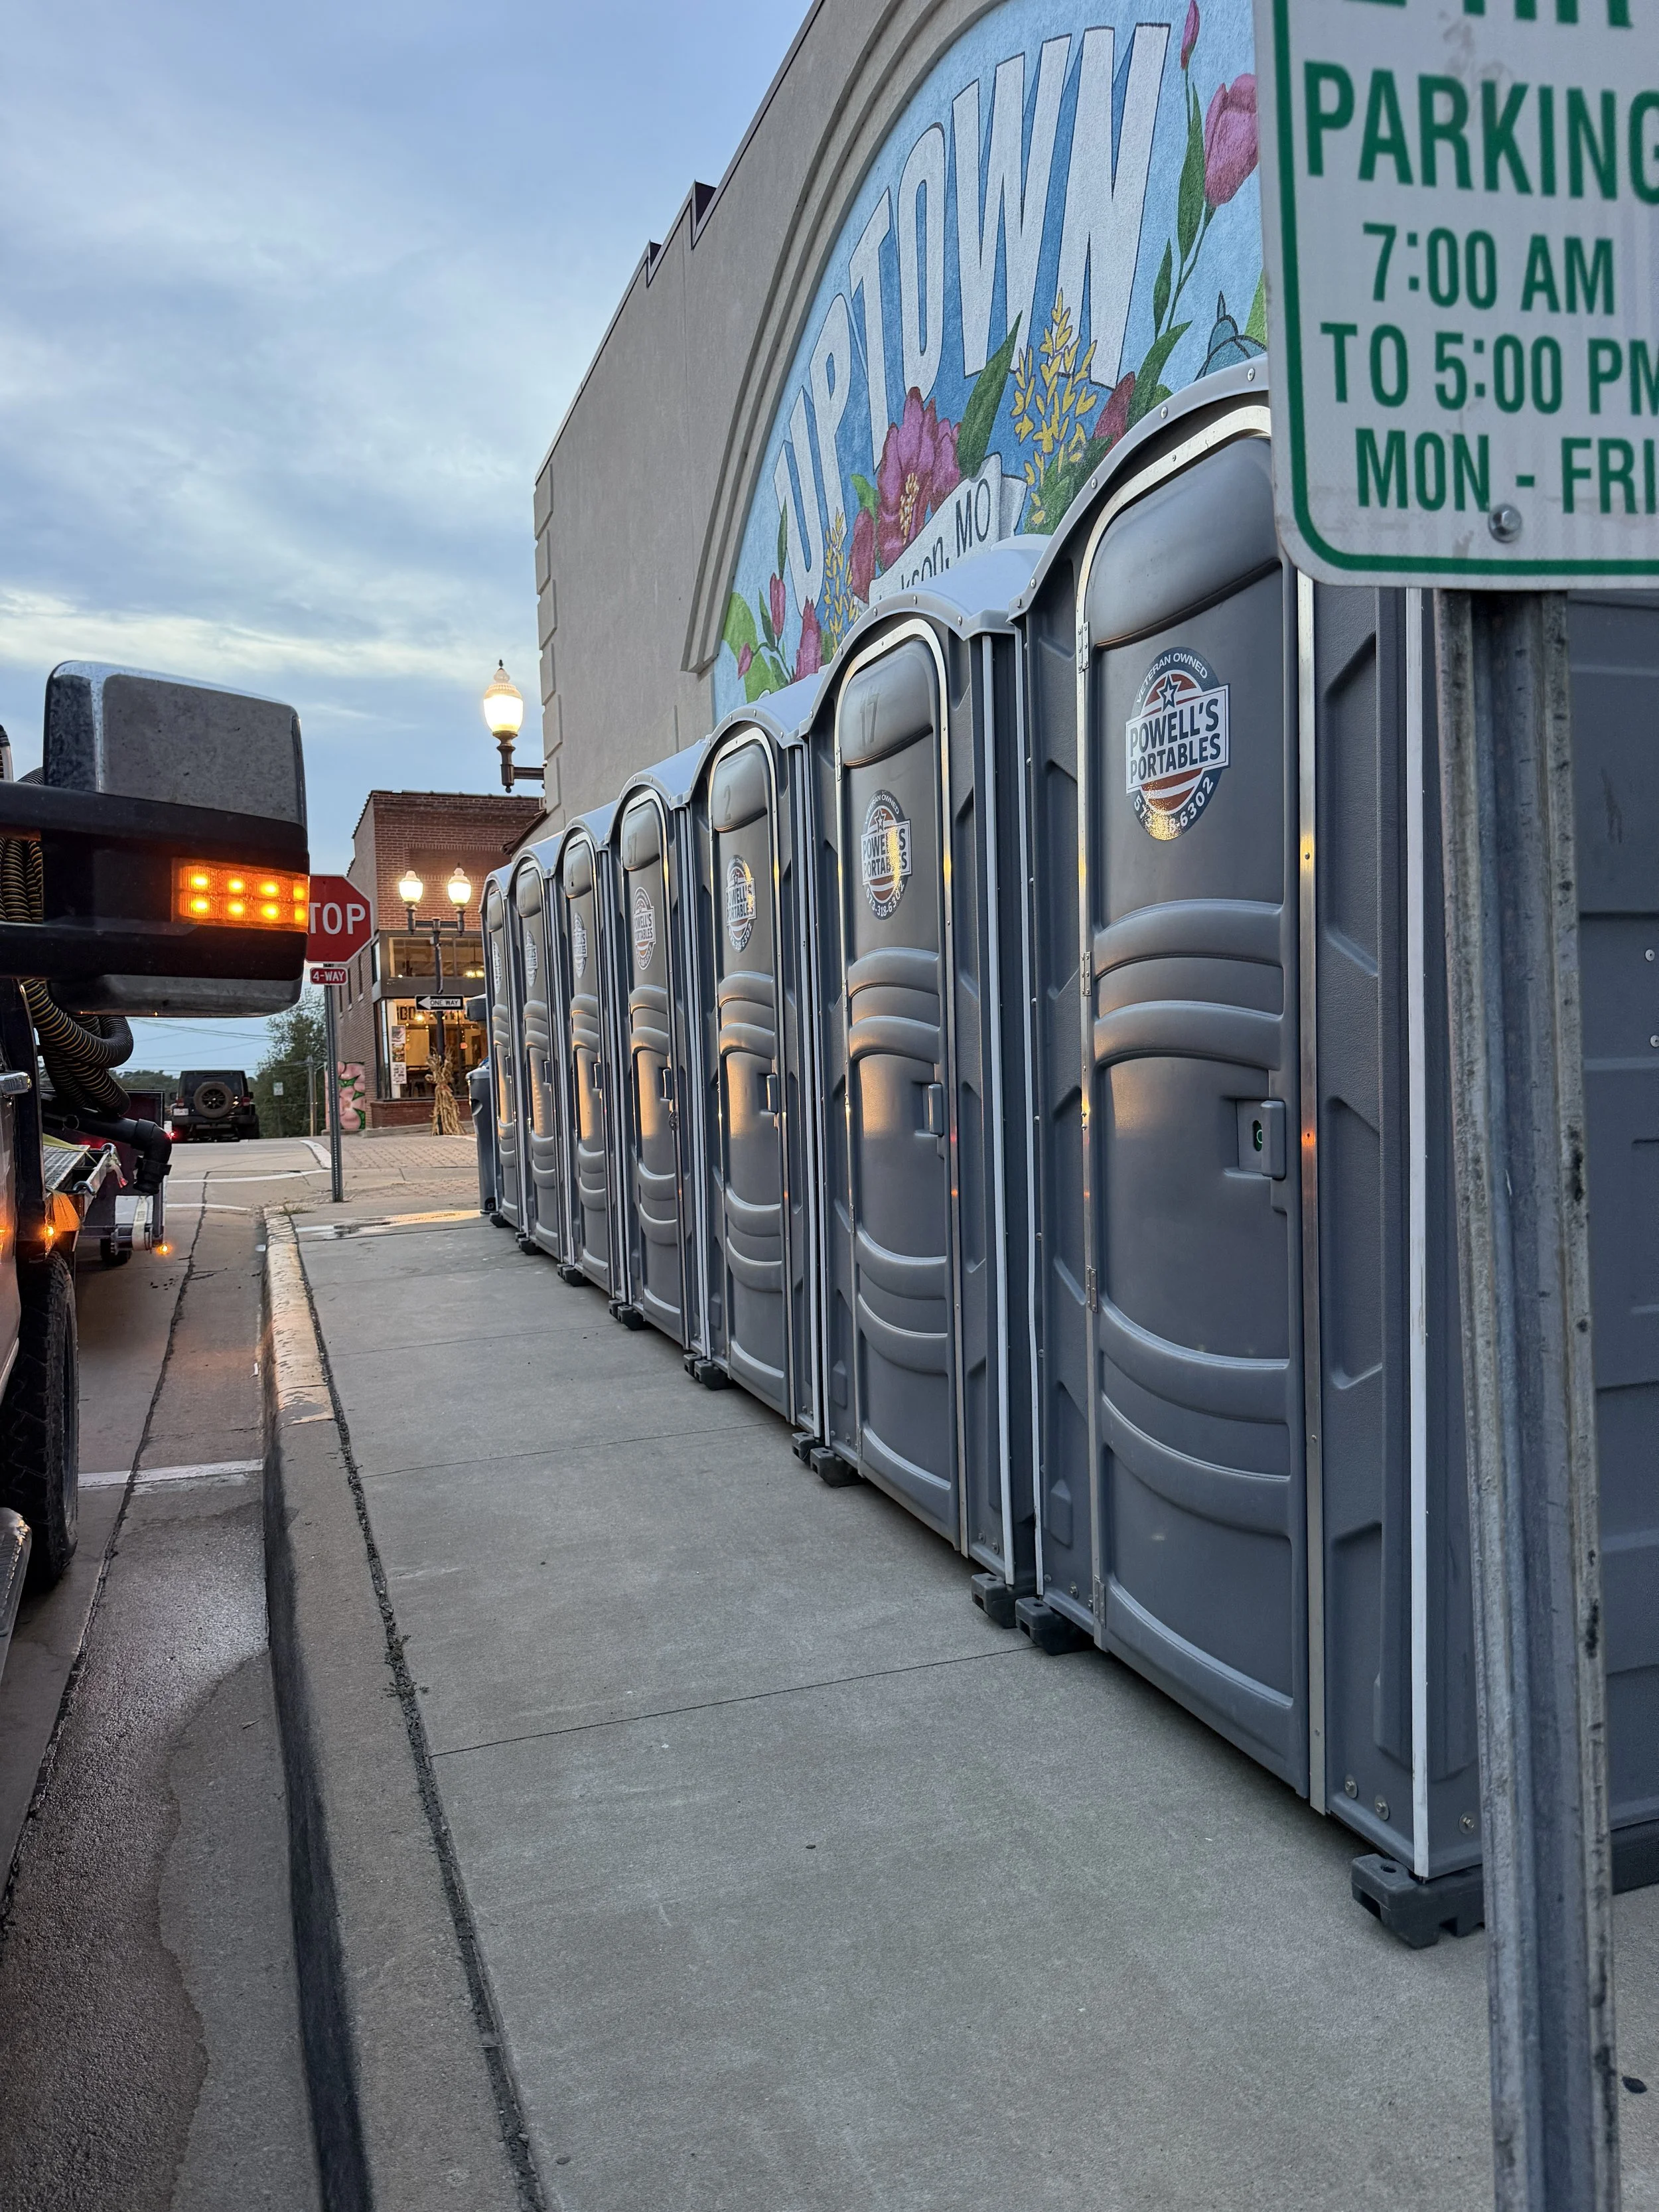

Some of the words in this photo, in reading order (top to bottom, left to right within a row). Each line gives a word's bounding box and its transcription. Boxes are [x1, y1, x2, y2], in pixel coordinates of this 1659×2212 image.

[1304, 60, 1659, 205] PARKING
[1363, 222, 1498, 310] 7:00
[1520, 234, 1615, 315] AM
[773, 23, 1171, 611] UPTOWN
[1321, 322, 1409, 407] TO
[1434, 331, 1563, 415] 5:00
[1355, 428, 1490, 513] MON
[1561, 437, 1657, 515] FRI
[956, 479, 991, 558] MO
[1135, 654, 1171, 703] VETERAN
[1173, 653, 1208, 679] OWNED
[1130, 698, 1220, 757] POWELL'S
[1130, 733, 1221, 784] PORTABLES
[863, 828, 906, 860] POWES
[864, 851, 907, 879] PORTABS
[309, 903, 366, 934] TOP
[313, 971, 344, 982] 4-WAY
